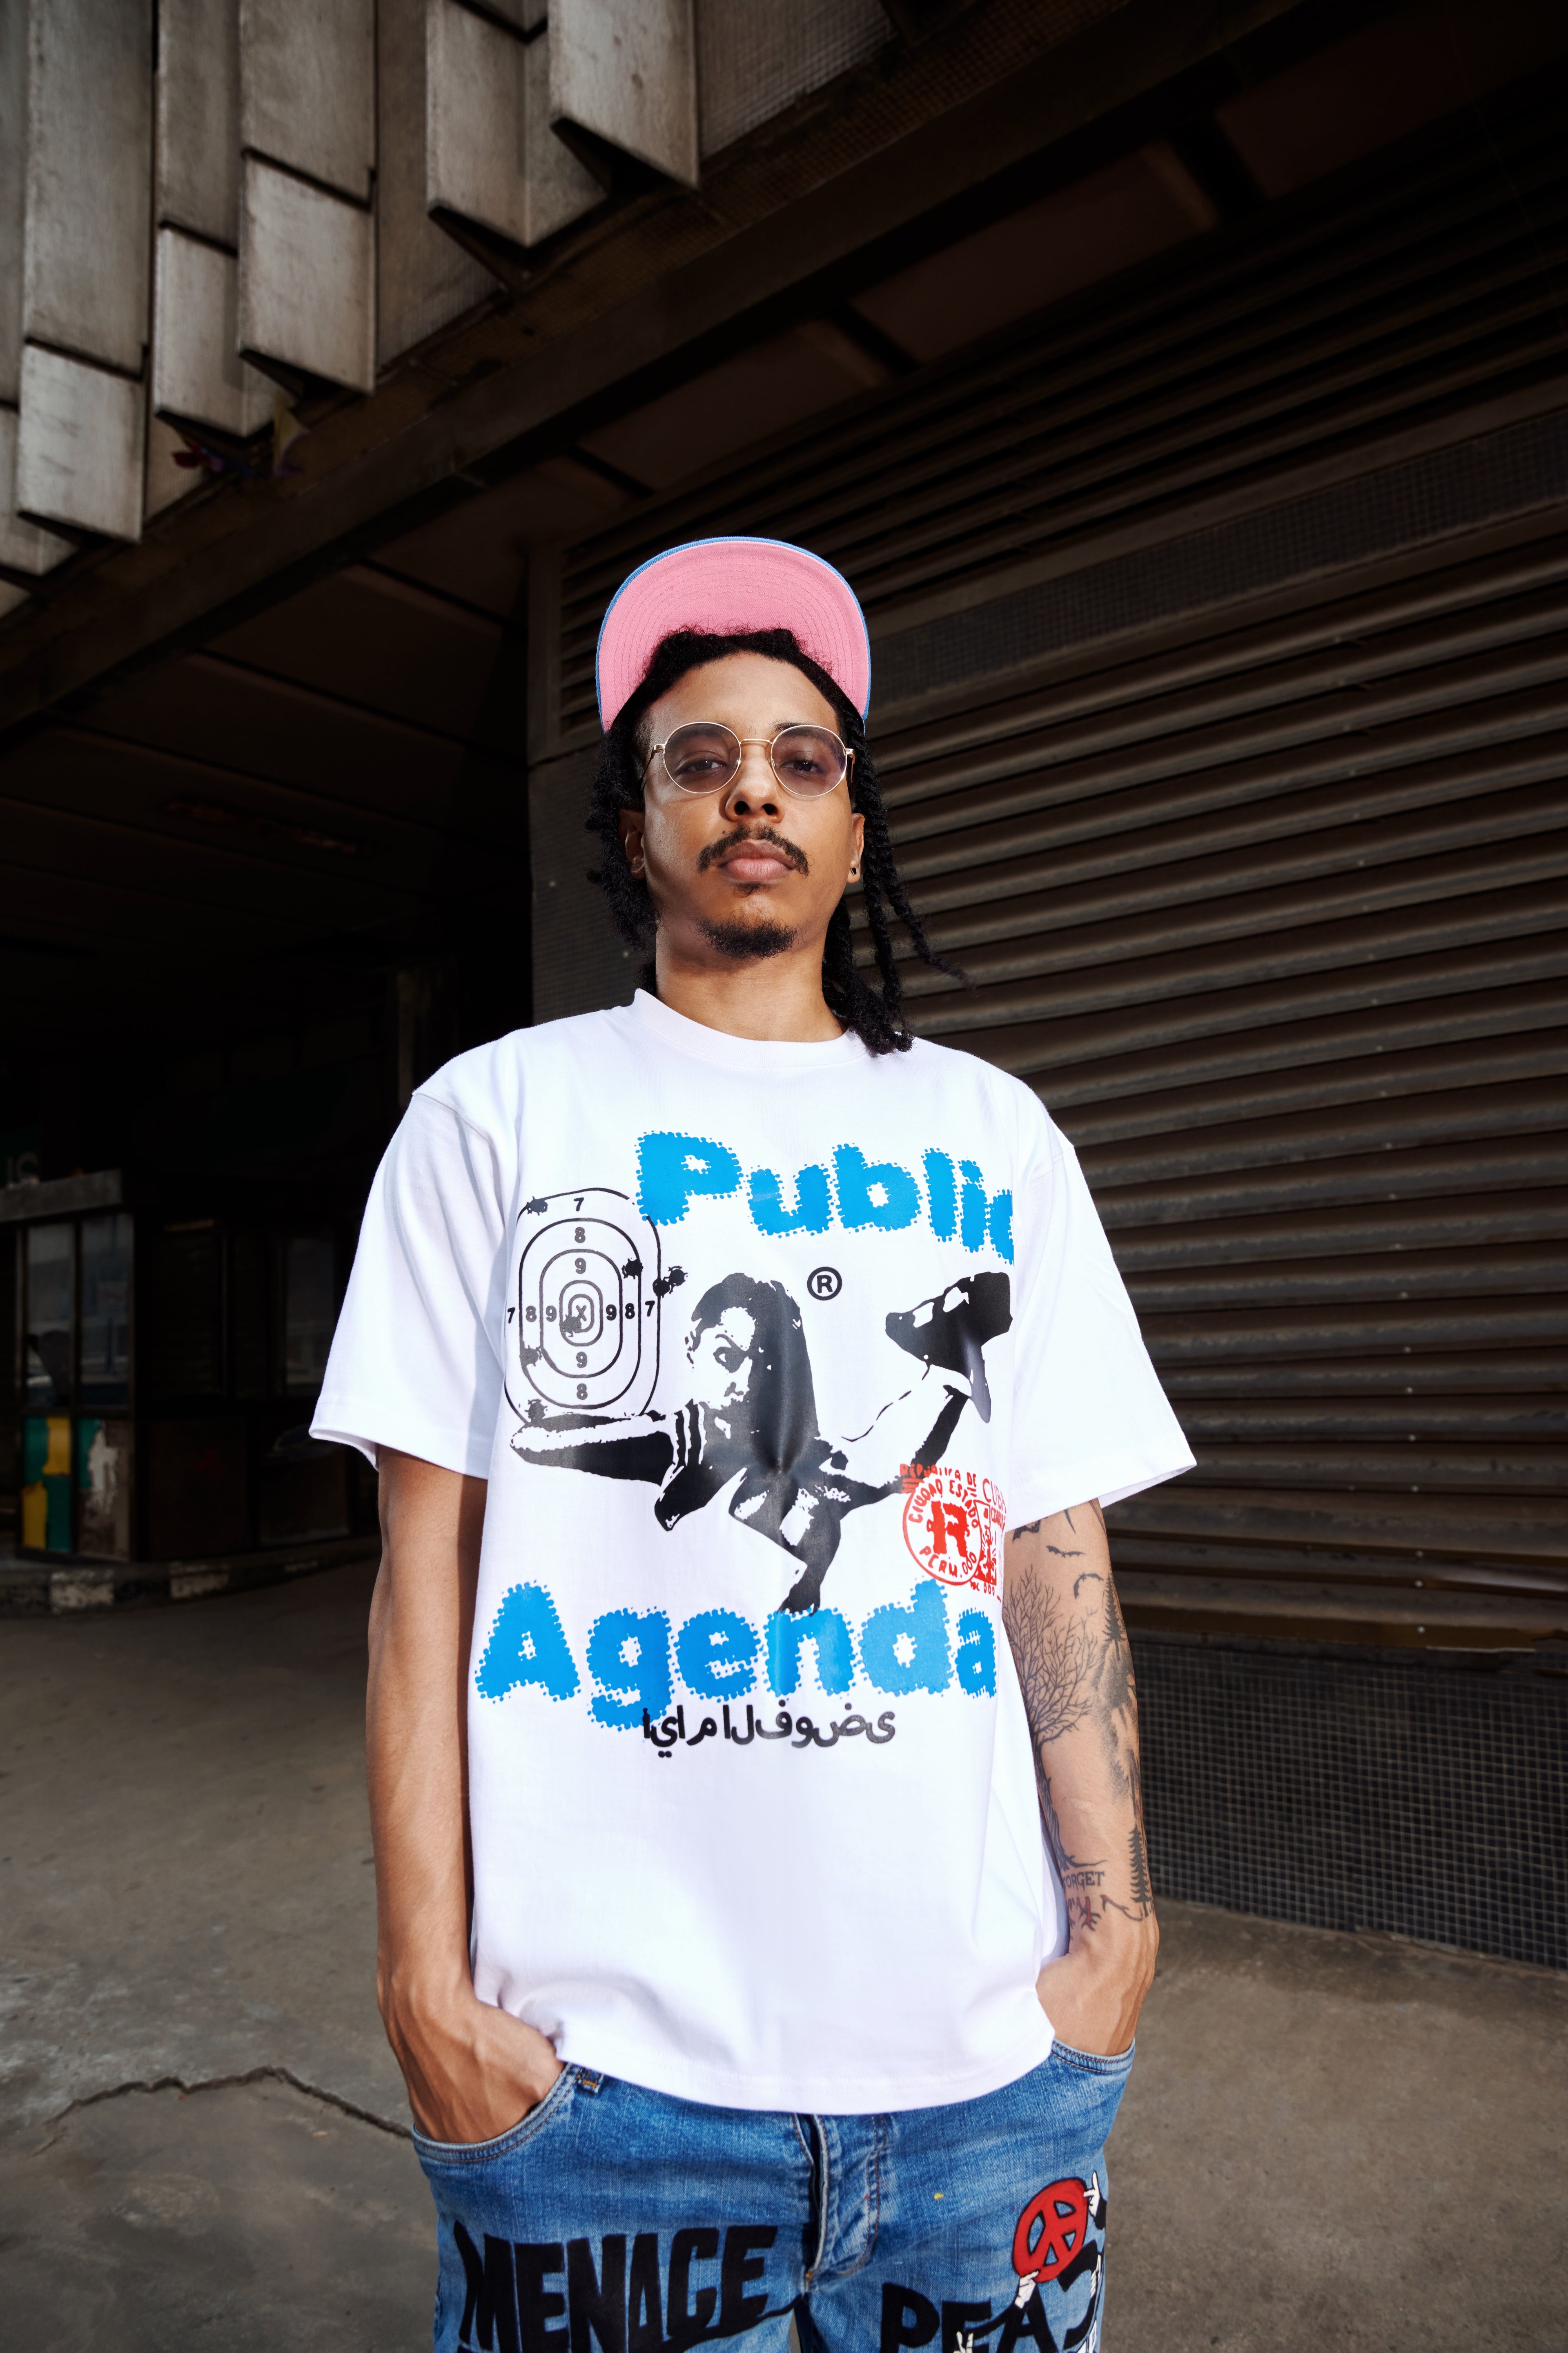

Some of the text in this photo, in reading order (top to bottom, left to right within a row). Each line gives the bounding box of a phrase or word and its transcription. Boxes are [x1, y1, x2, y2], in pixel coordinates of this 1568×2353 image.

[574, 1198, 584, 1211] 7
[575, 1227, 586, 1243] 8
[575, 1258, 586, 1274] 9
[508, 1307, 516, 1323] 7
[526, 1306, 537, 1322] 8
[546, 1306, 557, 1322] 9
[606, 1304, 617, 1320] 9
[625, 1303, 635, 1319] 8
[645, 1301, 655, 1316] 7
[577, 1352, 588, 1368] 9
[577, 1383, 588, 1400] 8
[474, 1579, 997, 1730] Agenda
[453, 2220, 778, 2353] MENACE
